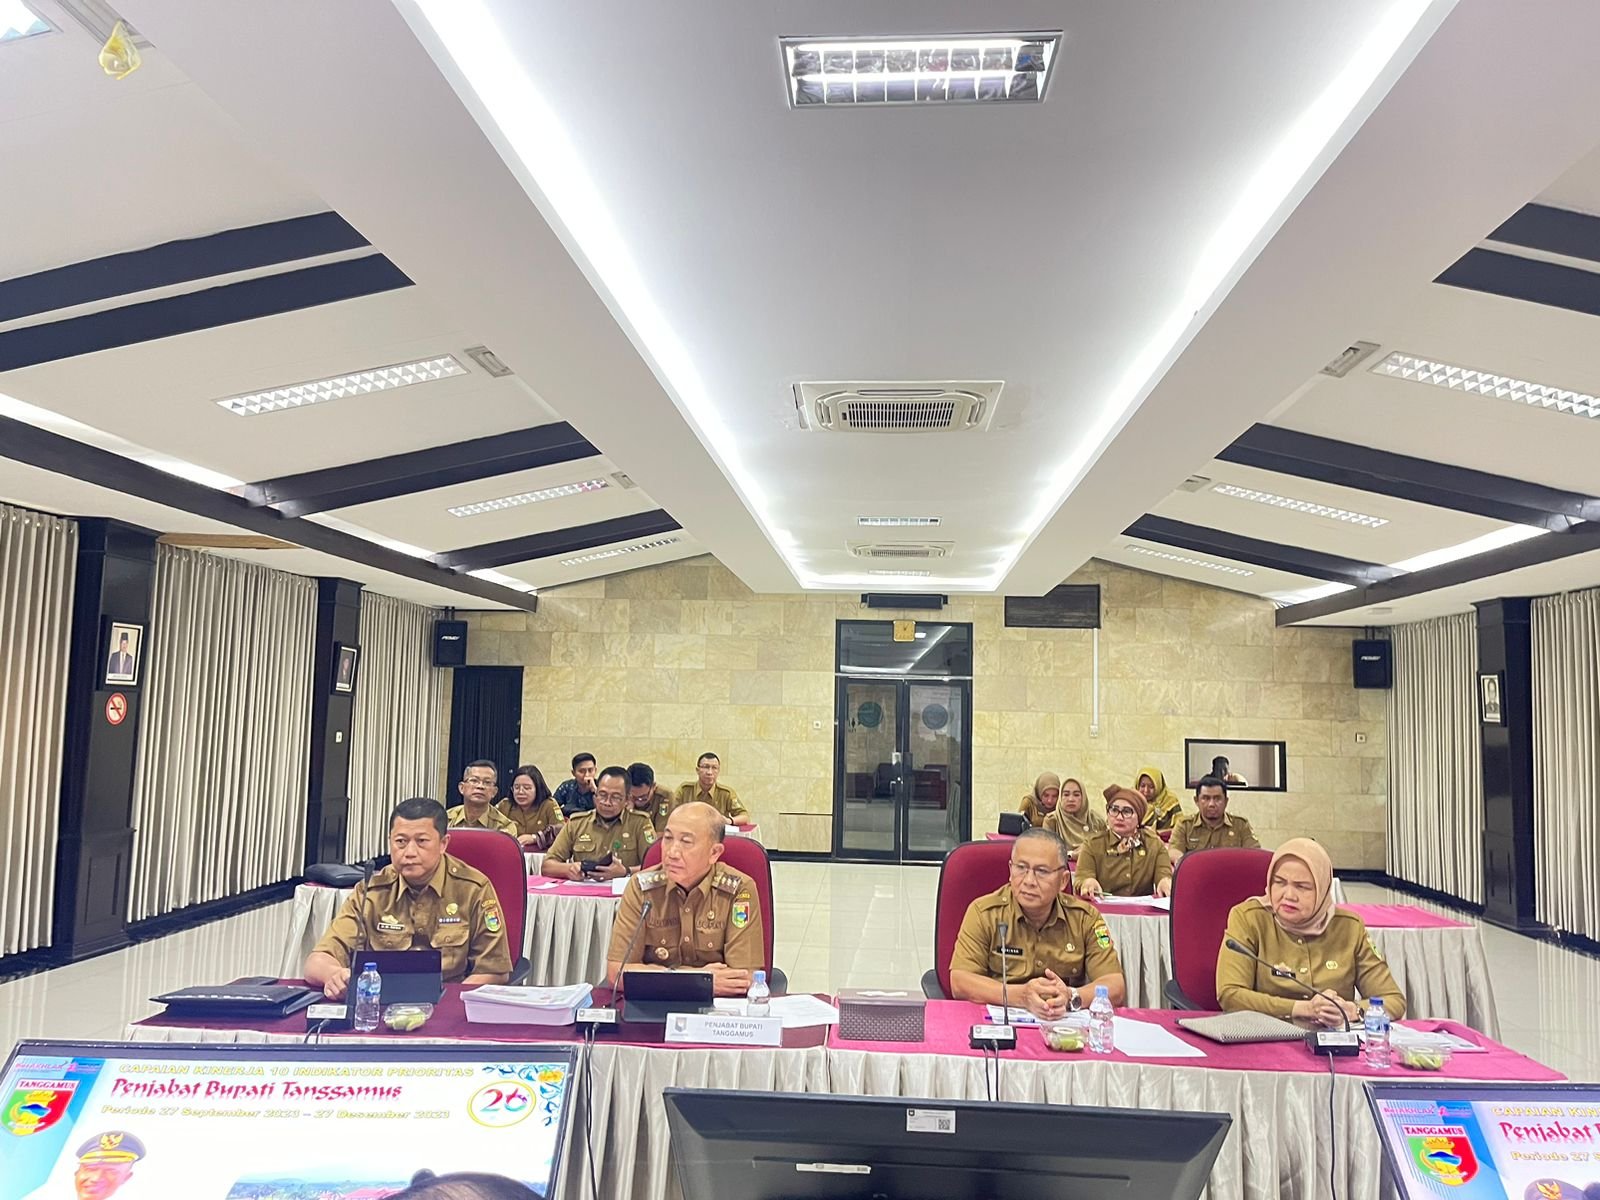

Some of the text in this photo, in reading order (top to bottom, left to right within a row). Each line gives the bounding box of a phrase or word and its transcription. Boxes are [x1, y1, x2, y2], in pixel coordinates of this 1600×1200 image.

[704, 1021, 763, 1030] PENJABAT BUPATI
[712, 1029, 754, 1038] TANGGAMUS
[119, 1063, 474, 1077] CAPAIAN KINERJA 10 INDIKATOR PRIORITAS
[19, 1080, 76, 1090] TANGGAMUS
[112, 1078, 402, 1100] Penjabat Bupati Tanggamus
[101, 1105, 156, 1115] Periode
[159, 1106, 180, 1116] 27
[181, 1106, 261, 1118] September
[336, 1109, 411, 1119] Desember
[1491, 1106, 1600, 1118] CAPAIAN KIN
[1403, 1126, 1465, 1136] TANGGAMUS
[1498, 1120, 1592, 1142] Penjabat
[1510, 1151, 1569, 1161] Periode
